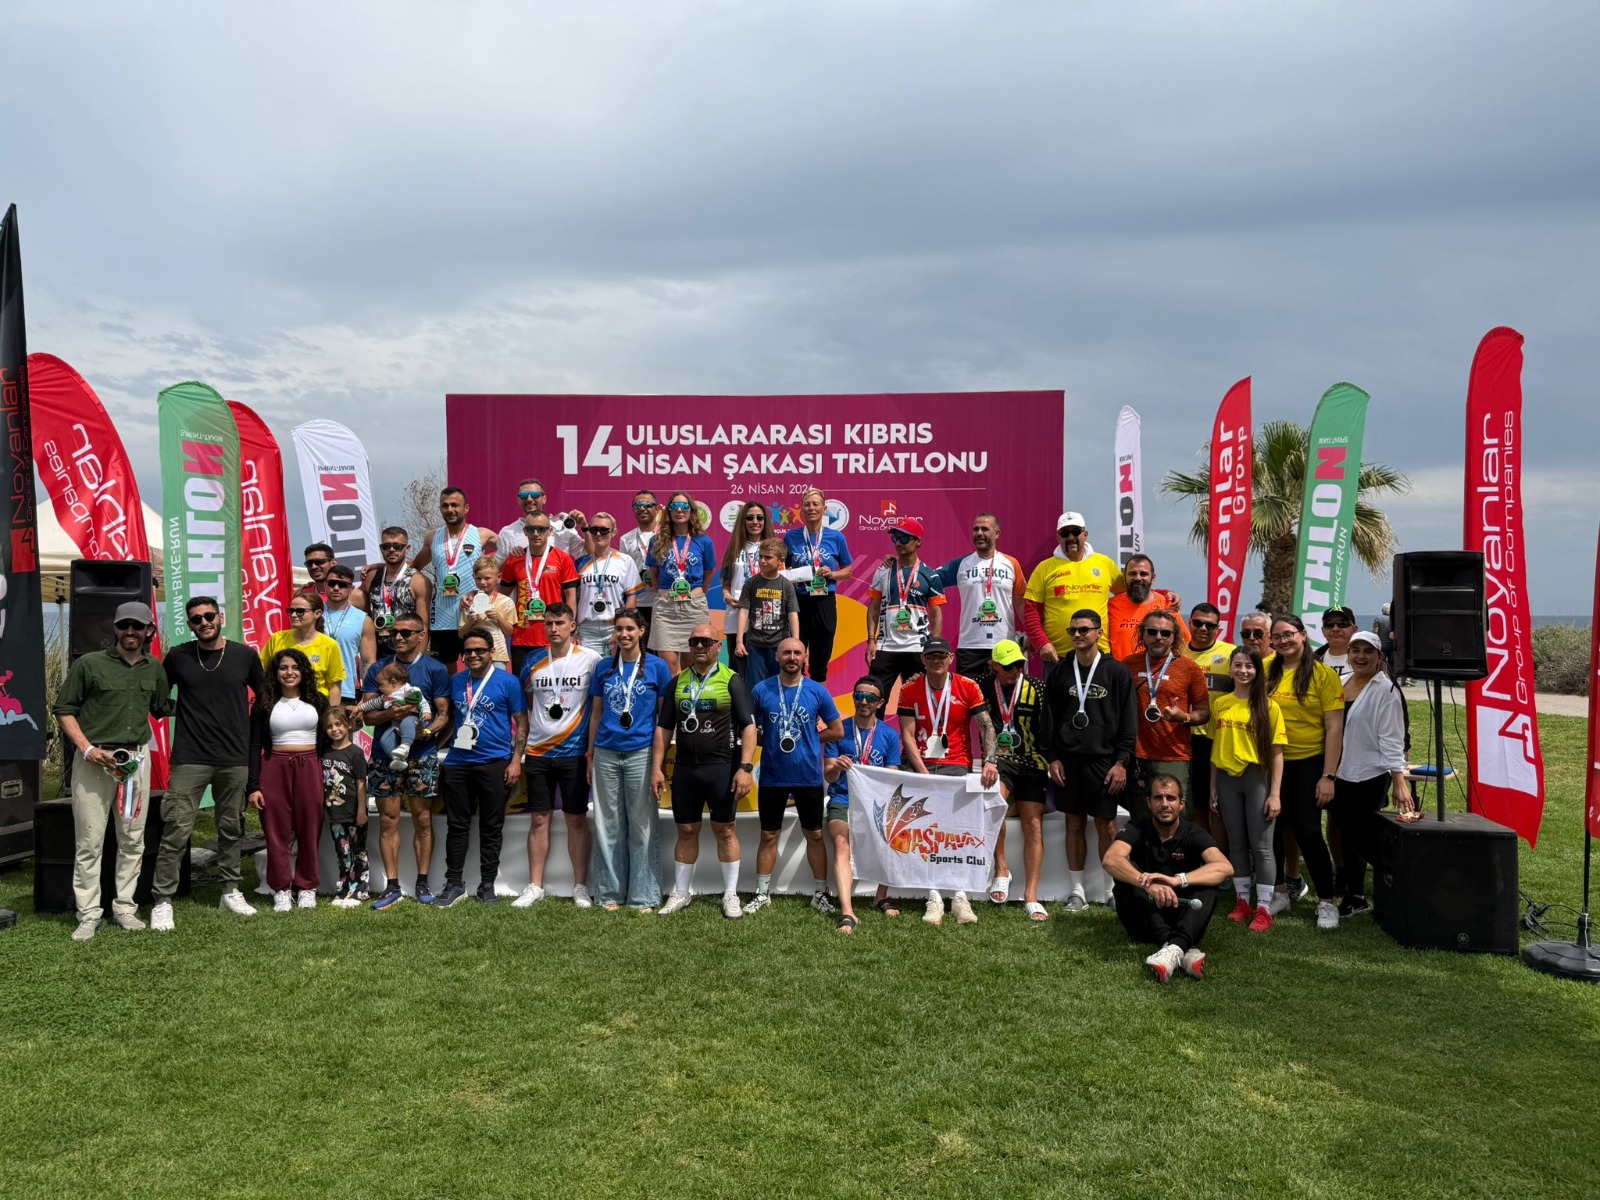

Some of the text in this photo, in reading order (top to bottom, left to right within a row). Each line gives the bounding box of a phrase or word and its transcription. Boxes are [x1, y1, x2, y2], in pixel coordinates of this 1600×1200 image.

[0, 367, 26, 524] Noyanlar
[556, 425, 622, 476] 14
[626, 422, 933, 446] ULUSLARARASI KIBRIS
[626, 447, 988, 480] NİSAN ŞAKASI TRİATLONU
[730, 484, 745, 495] 26
[749, 482, 785, 495] NİSAN
[1232, 426, 1248, 515] Group
[1502, 410, 1515, 572] Companies
[1333, 527, 1348, 606] -BIKE-RUN
[1477, 413, 1511, 701] Noyanlar
[1511, 614, 1528, 705] Group
[911, 826, 976, 854] ASPAVA
[930, 854, 963, 864] Sports
